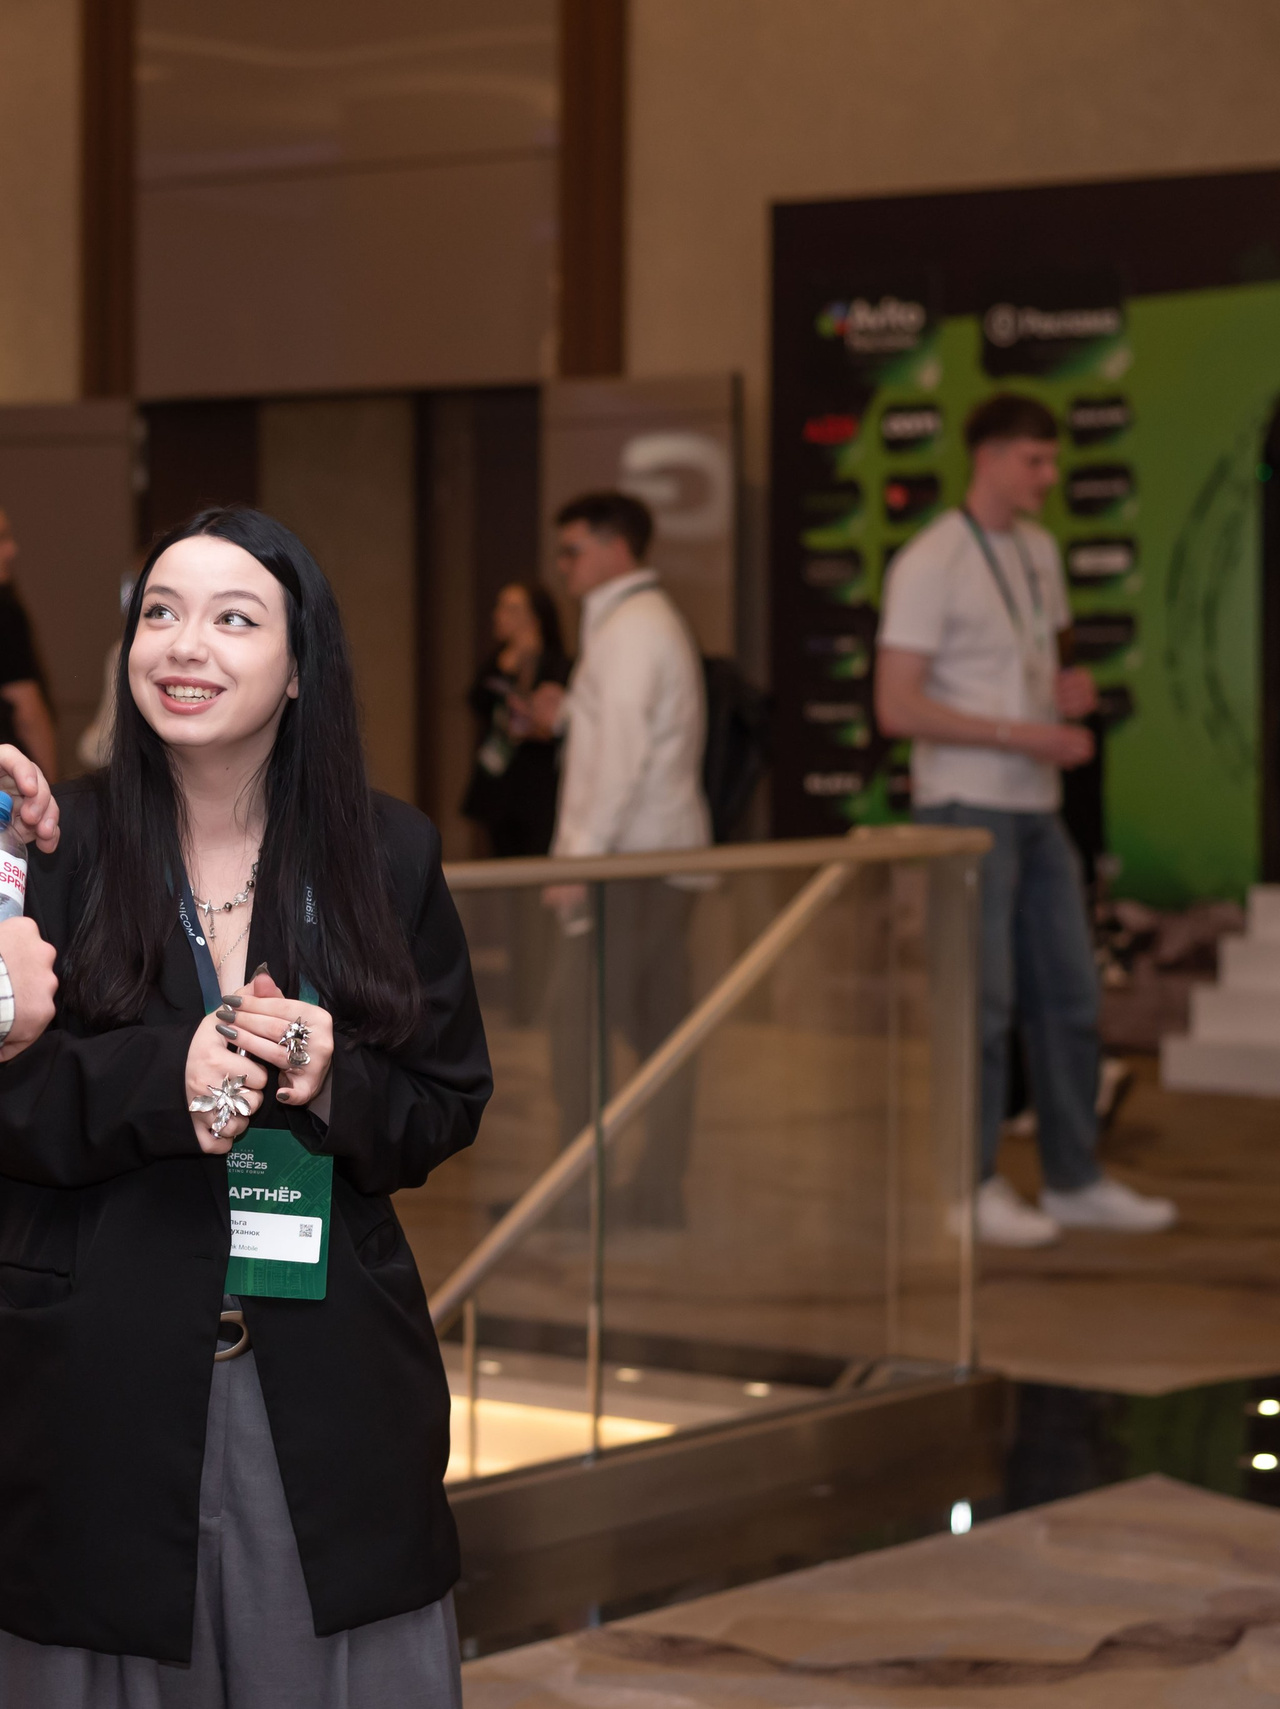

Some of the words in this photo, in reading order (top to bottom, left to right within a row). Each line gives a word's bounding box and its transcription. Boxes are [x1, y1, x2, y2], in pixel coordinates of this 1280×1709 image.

[178, 893, 196, 938] NICOM
[227, 1152, 254, 1160] RFOR
[227, 1160, 267, 1169] ANCE'25
[229, 1186, 301, 1202] АРТНЁР
[230, 1228, 260, 1236] уханюк
